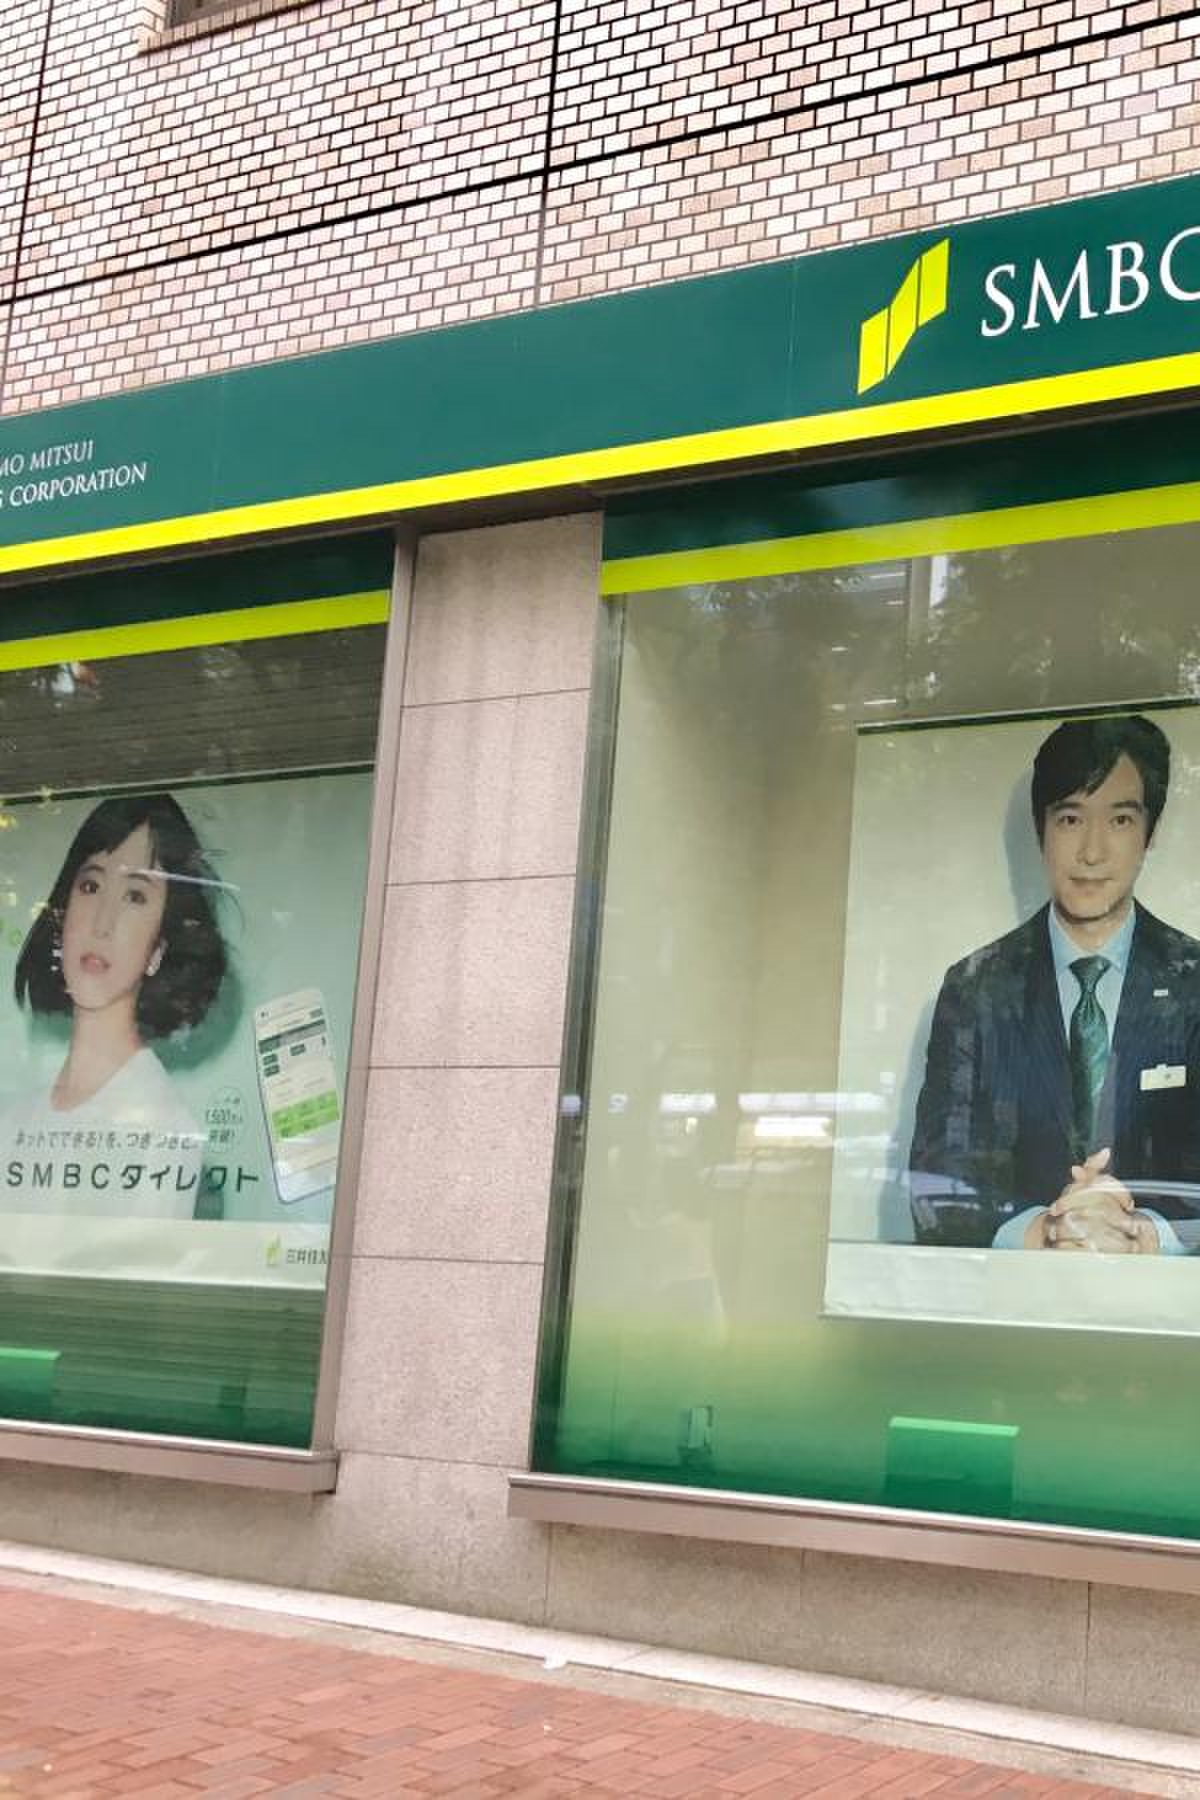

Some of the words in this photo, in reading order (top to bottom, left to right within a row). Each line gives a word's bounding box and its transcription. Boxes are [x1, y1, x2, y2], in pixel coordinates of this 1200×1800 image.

[30, 439, 94, 471] MITSUI
[10, 461, 148, 507] CORPORATION
[6, 1160, 259, 1194] SMBCダイレクト
